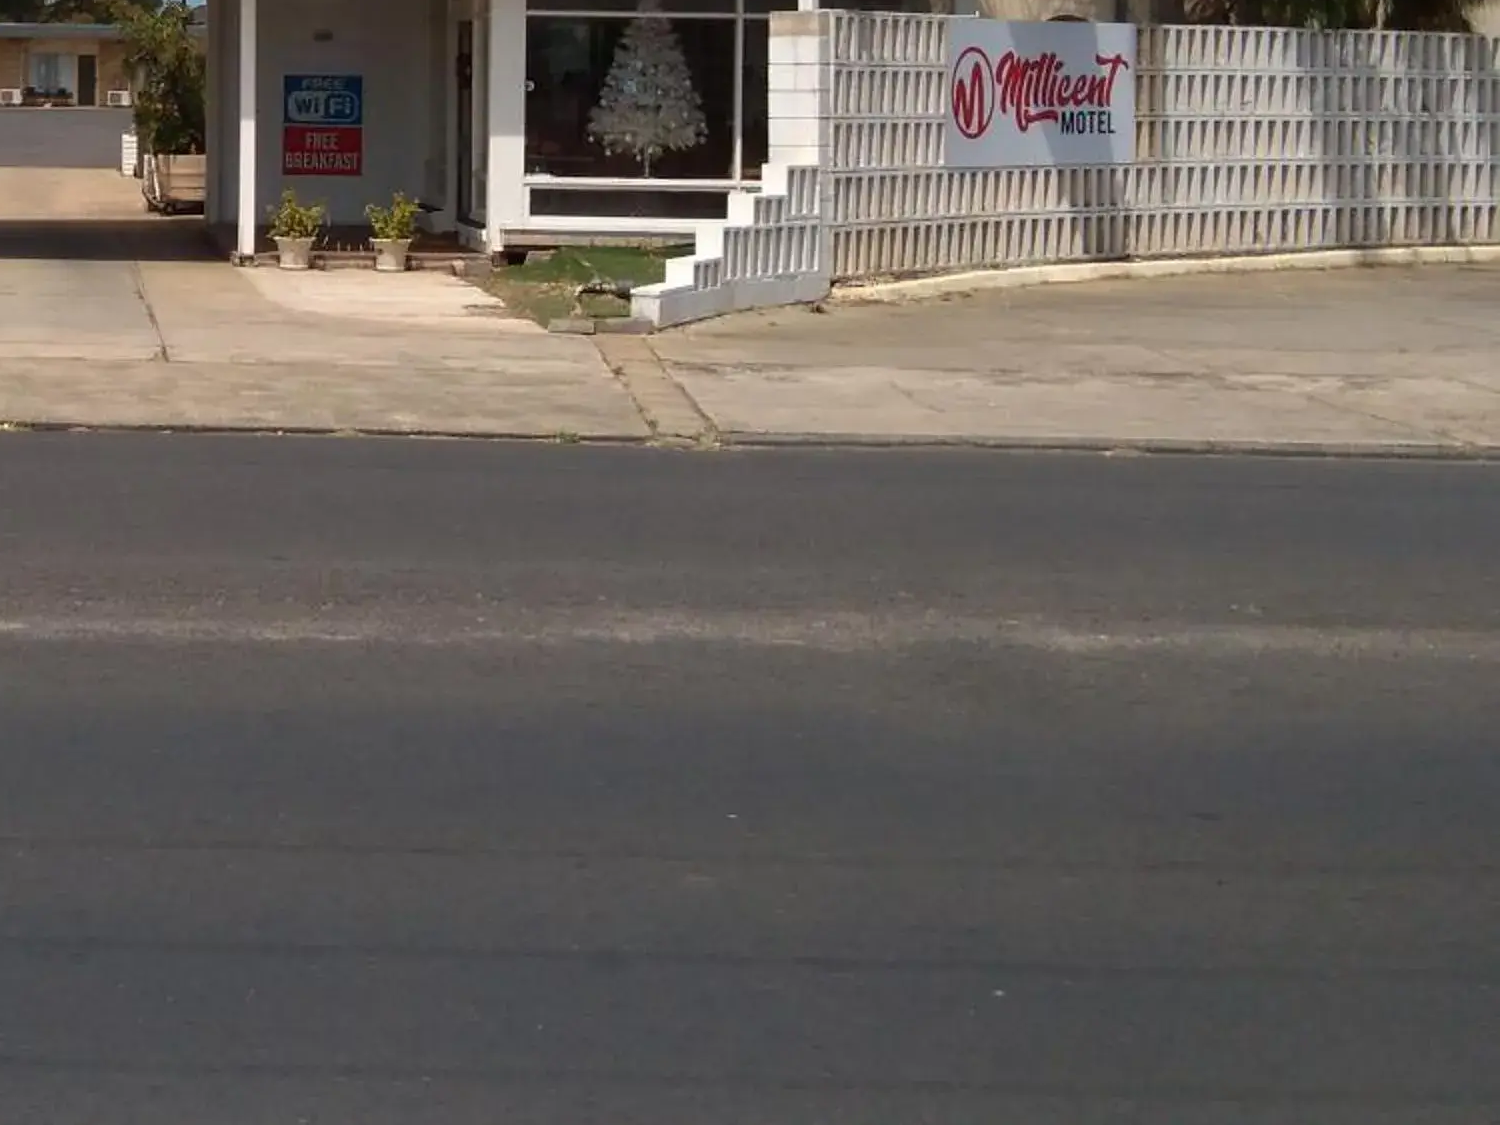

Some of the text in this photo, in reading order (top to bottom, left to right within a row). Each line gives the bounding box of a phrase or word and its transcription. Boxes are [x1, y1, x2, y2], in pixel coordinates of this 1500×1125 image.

[301, 78, 348, 91] FREE
[995, 51, 1129, 133] Millicent
[1060, 111, 1116, 135] MOTEL
[305, 132, 340, 150] FREE
[285, 152, 359, 171] BREAKFAST
